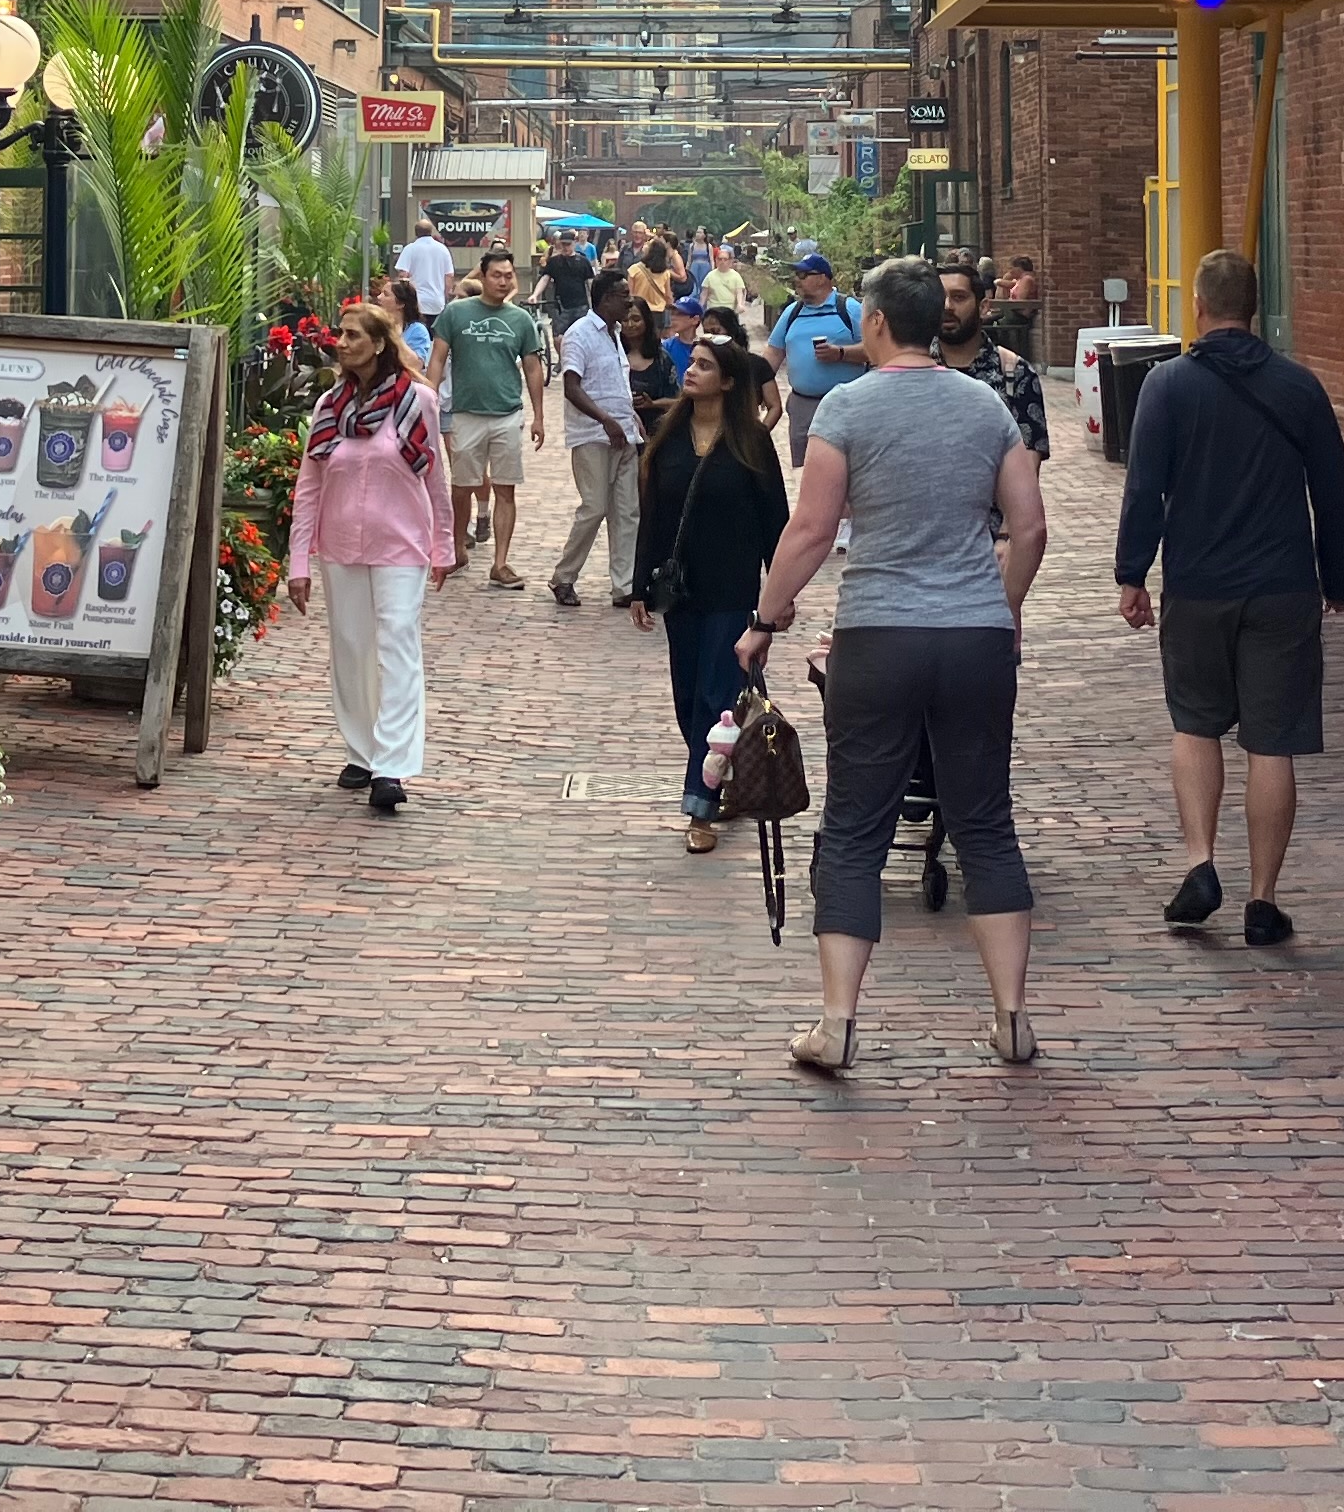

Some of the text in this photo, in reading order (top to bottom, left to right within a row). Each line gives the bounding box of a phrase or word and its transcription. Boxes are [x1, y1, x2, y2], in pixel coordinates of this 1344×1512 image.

[223, 57, 283, 77] CUNY
[367, 103, 406, 120] Mill
[909, 154, 949, 164] GELATO
[437, 221, 493, 232] POUTINE
[96, 354, 127, 372] Cold
[129, 356, 177, 406] Chocolate
[89, 473, 138, 485] The Brittany
[34, 490, 75, 500] The Dubai
[85, 603, 137, 615] Raspberry &
[28, 619, 74, 630] Stone Fruit
[82, 613, 136, 626] Pomegranate
[27, 633, 38, 643] to
[40, 634, 63, 646] treat
[65, 637, 111, 649] yourself!
